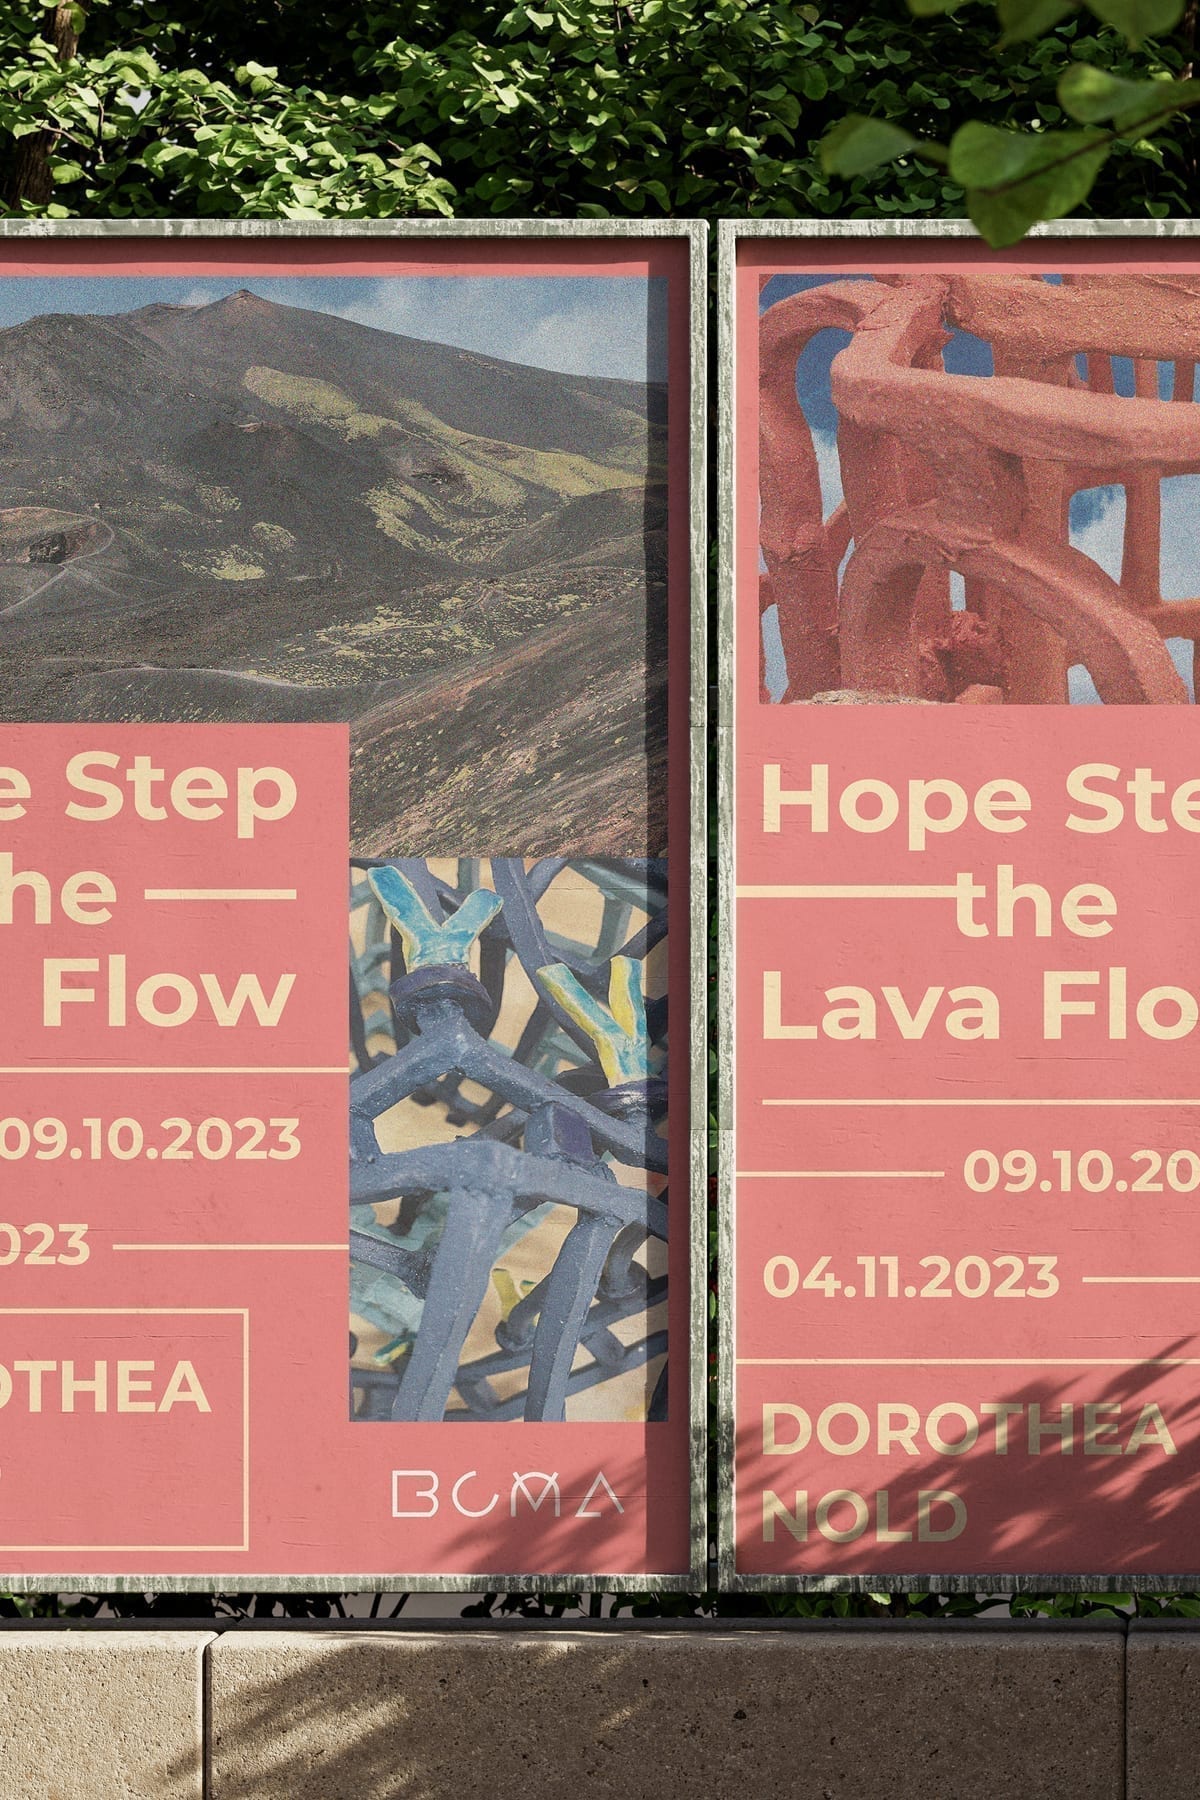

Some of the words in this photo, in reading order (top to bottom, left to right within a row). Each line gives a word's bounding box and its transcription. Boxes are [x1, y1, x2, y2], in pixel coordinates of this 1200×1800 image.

[65, 751, 297, 838] Step
[763, 764, 1031, 851] Hope
[957, 864, 1117, 937] the
[44, 954, 296, 1027] Flow
[763, 971, 999, 1040] Lava
[0, 1117, 300, 1160] 09.10.2023
[764, 1255, 1059, 1298] 04.11.2023
[0, 1360, 211, 1412] THEA
[763, 1402, 1177, 1455] DOROTHEA
[763, 1490, 967, 1542] NOLD
